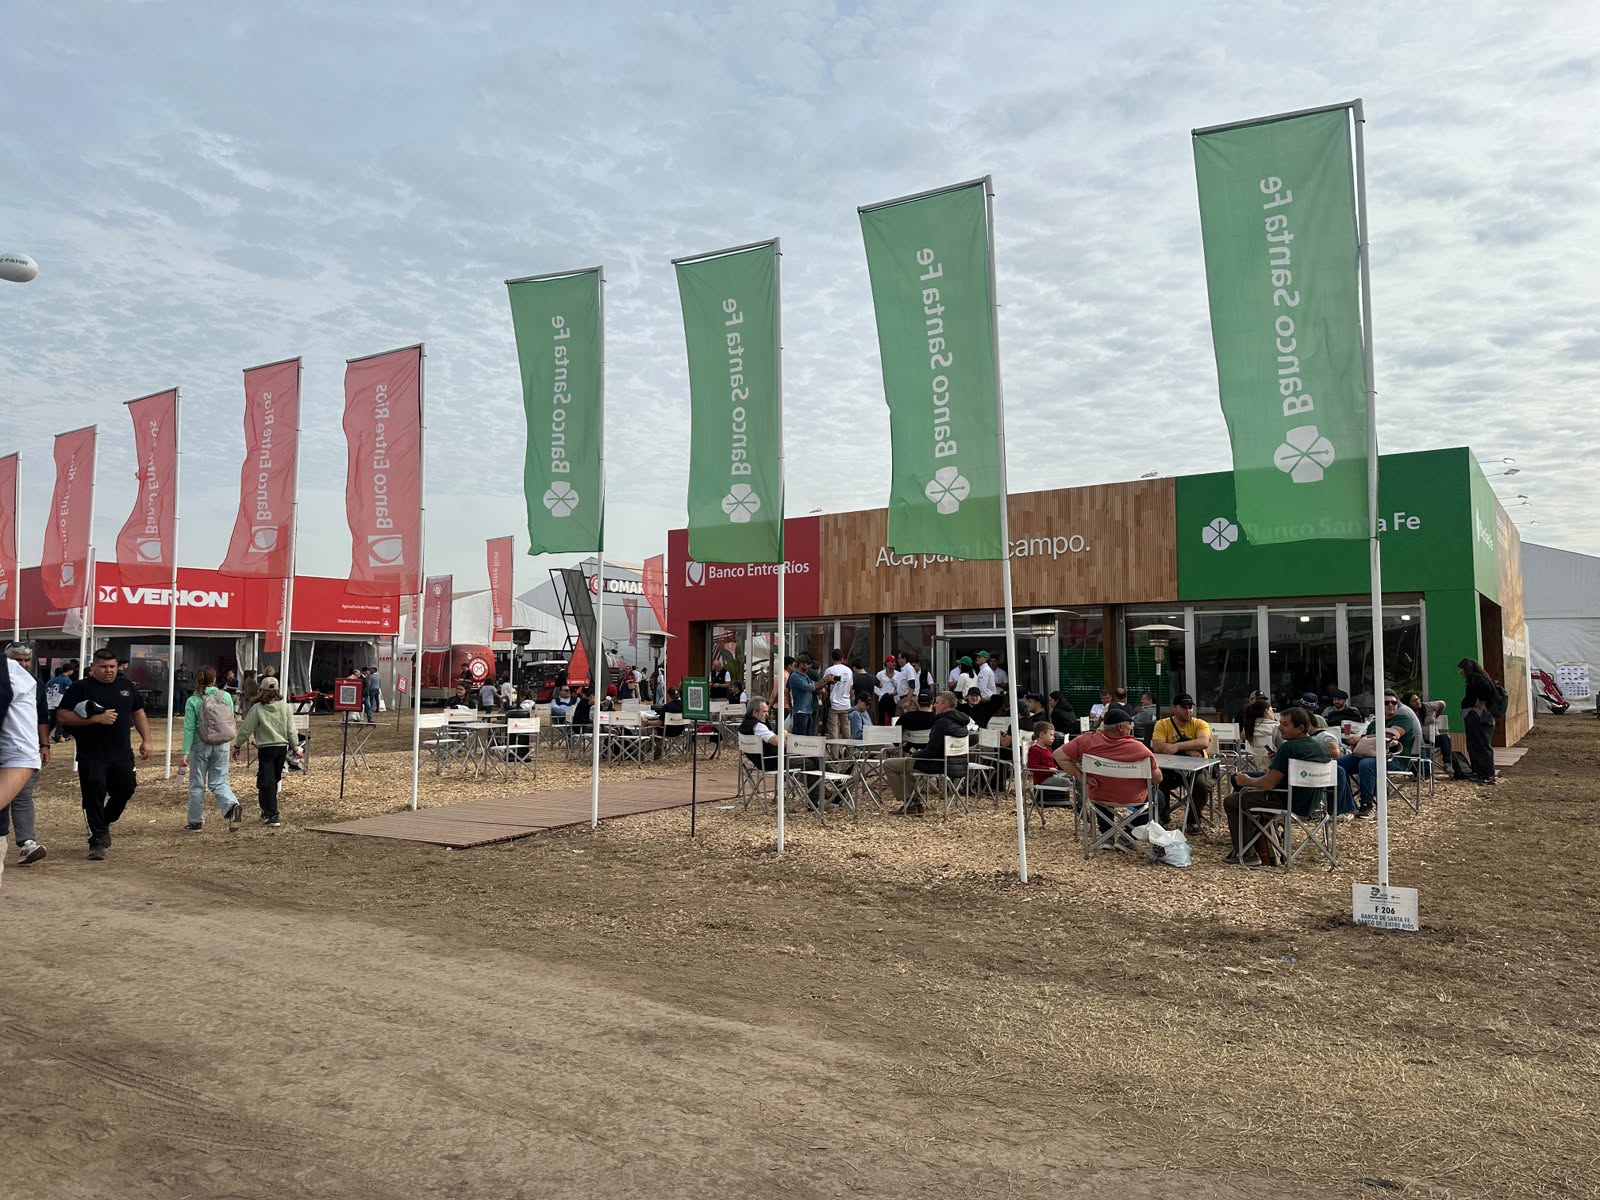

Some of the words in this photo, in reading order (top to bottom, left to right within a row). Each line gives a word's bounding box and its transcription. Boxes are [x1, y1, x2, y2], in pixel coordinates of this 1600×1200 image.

[1392, 511, 1421, 531] Fe
[1008, 534, 1091, 560] campo.
[708, 566, 745, 579] Banco
[747, 563, 779, 577] Entre
[783, 560, 810, 574] Ríos
[121, 587, 229, 608] VERION
[1381, 906, 1396, 915] 206
